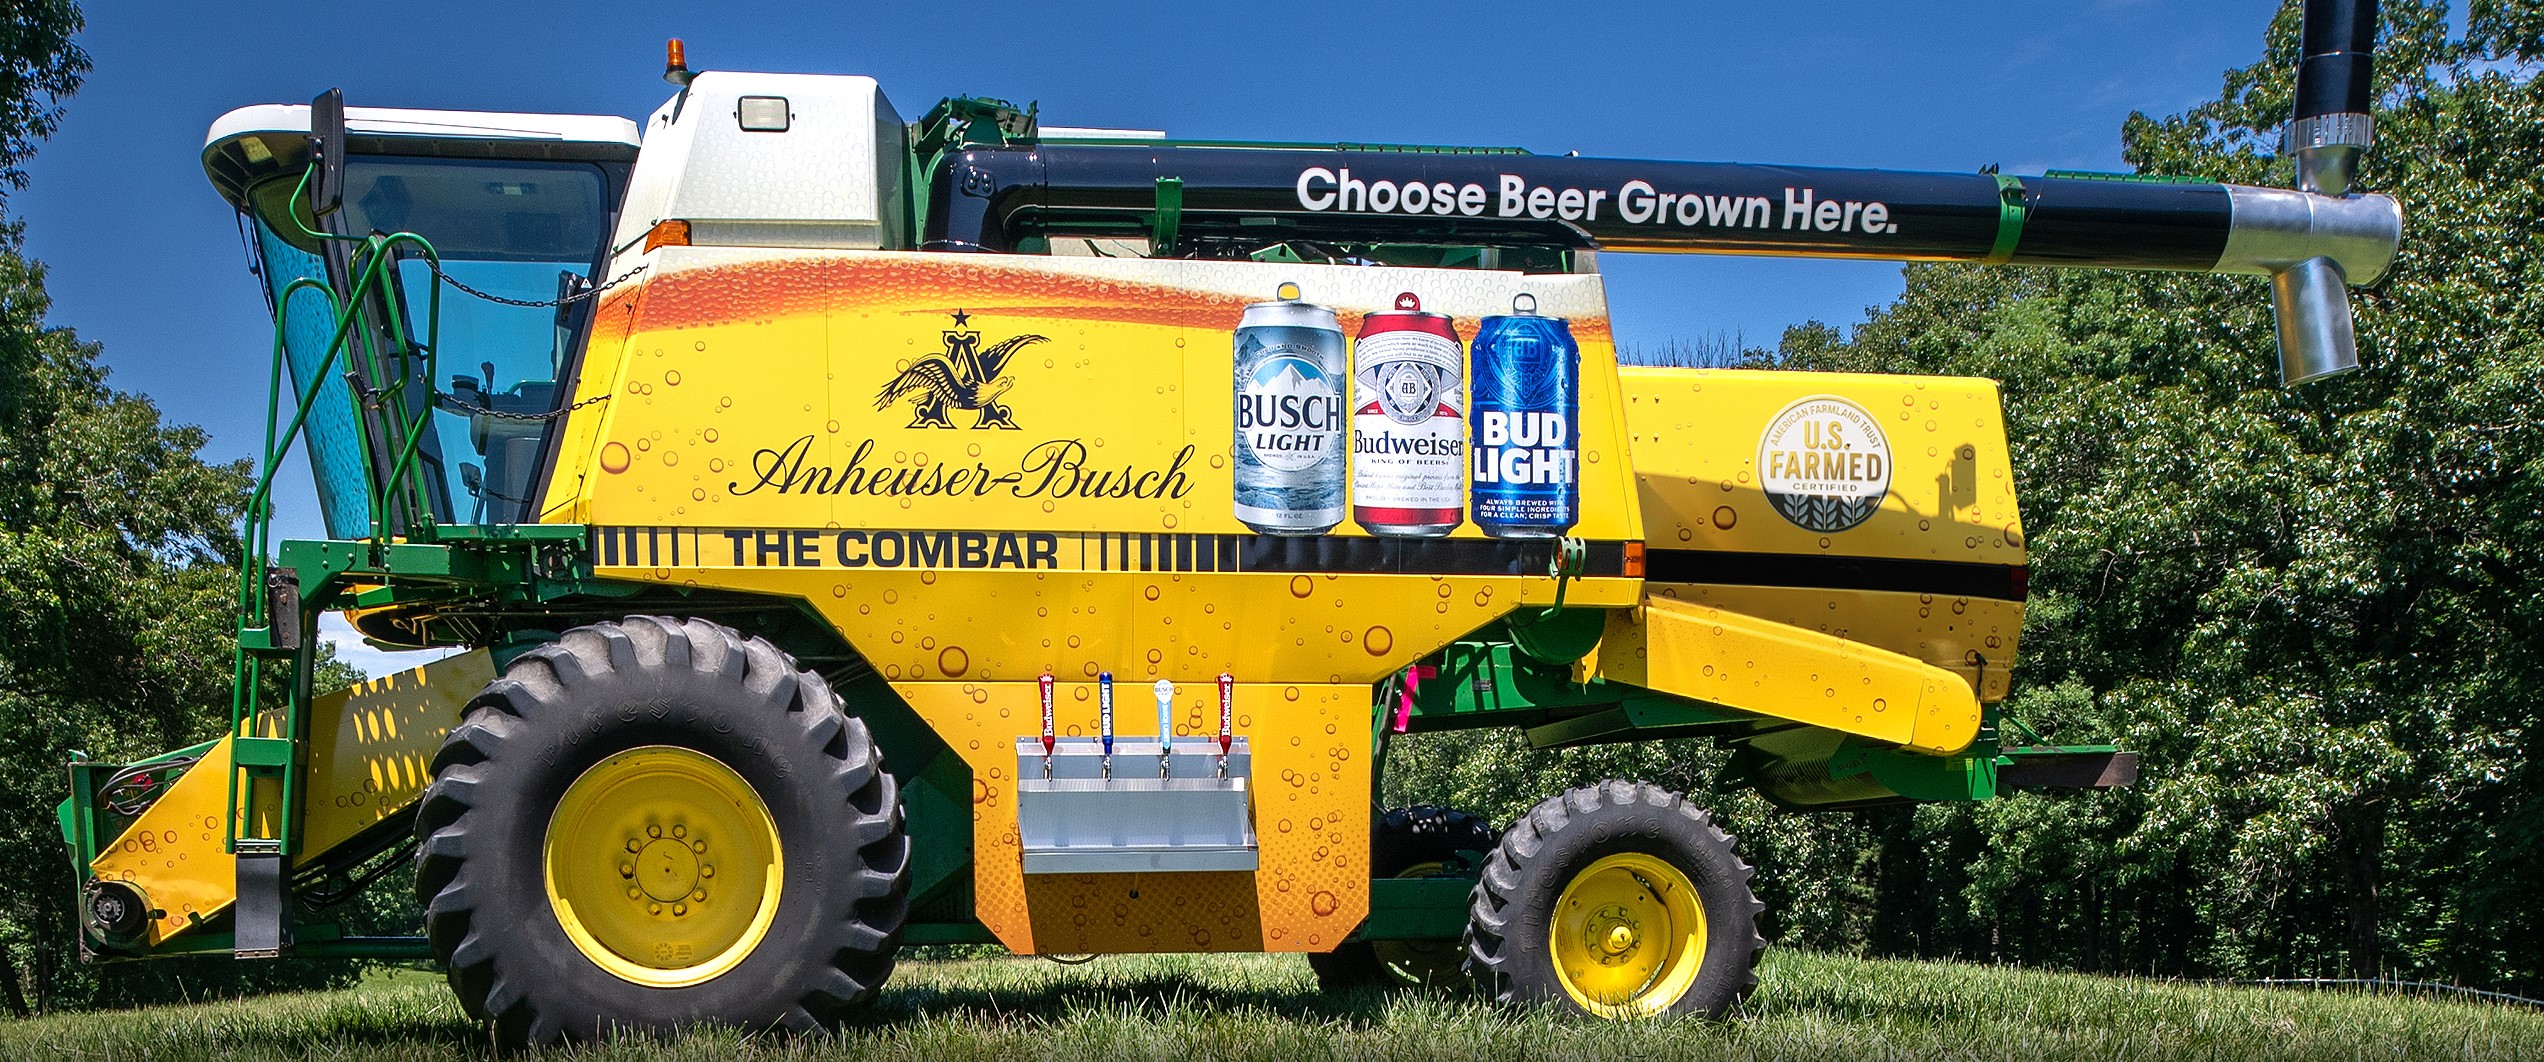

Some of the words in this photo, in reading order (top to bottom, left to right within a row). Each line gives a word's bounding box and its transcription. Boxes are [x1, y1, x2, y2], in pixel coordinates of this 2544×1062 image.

[1297, 167, 1487, 217] Choose
[1498, 174, 1606, 221] Beer
[1618, 180, 1772, 229] Grown
[1781, 187, 1898, 234] Here.
[1239, 394, 1340, 431] BUSCH
[1483, 411, 1567, 447] BUD
[1770, 407, 1809, 447] AMERICAN
[1810, 404, 1861, 424] FARMLAND
[1859, 421, 1881, 449] TRUST
[1255, 433, 1324, 451] LIGHT
[1354, 430, 1463, 457] Budweiser
[1804, 420, 1851, 450] U.S.
[728, 434, 1196, 499] Anheuser-Busch
[1474, 447, 1576, 484] LIGHT
[1769, 450, 1882, 481] FARMED
[1793, 482, 1858, 493] CERTIFIED
[724, 530, 821, 567] THE
[836, 531, 1058, 569] COMBAR
[1043, 684, 1053, 736] Budweiser
[1101, 683, 1110, 713] LIGHT
[1222, 683, 1231, 736] Budweiser
[1102, 714, 1111, 736] BUD
